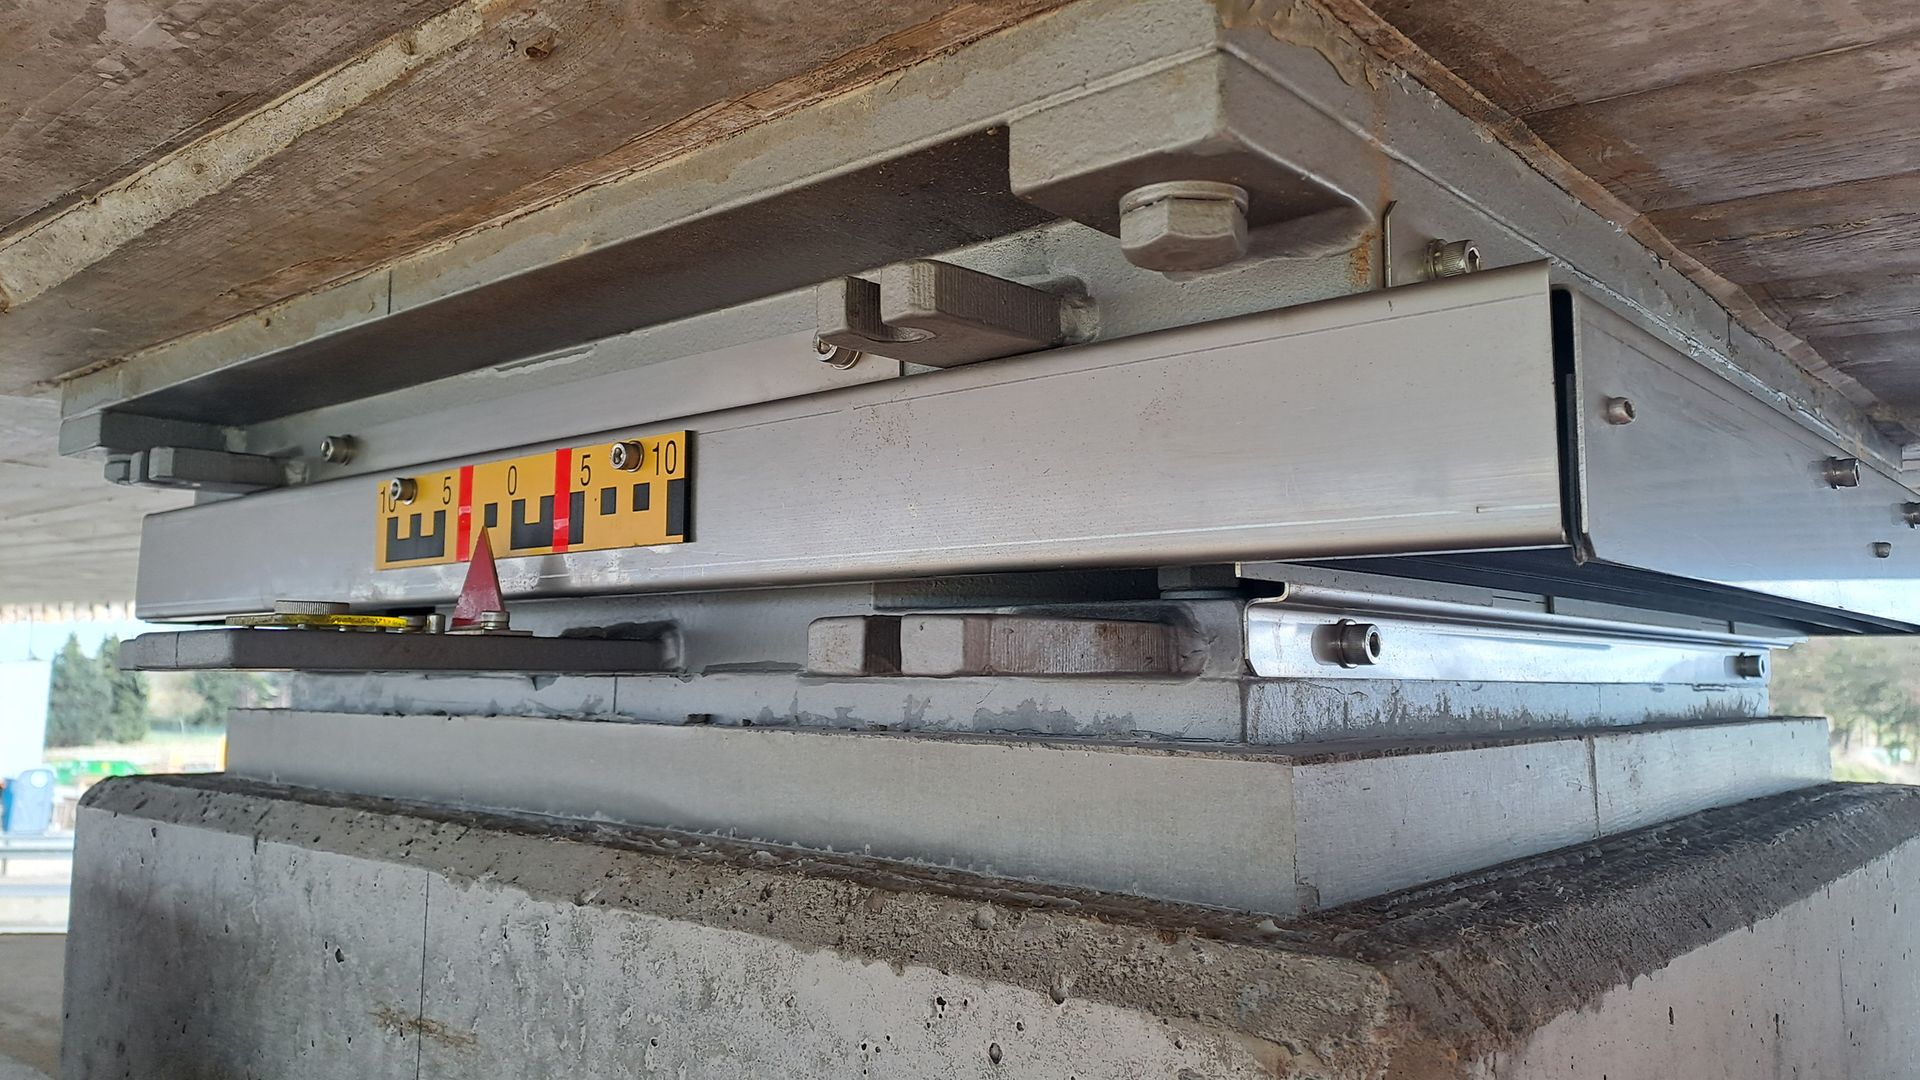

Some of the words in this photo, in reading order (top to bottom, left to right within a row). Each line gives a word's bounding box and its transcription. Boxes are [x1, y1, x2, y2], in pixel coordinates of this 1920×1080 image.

[442, 476, 452, 505] 5
[507, 465, 518, 496] 0
[580, 454, 592, 487] 5
[652, 440, 677, 476] 10
